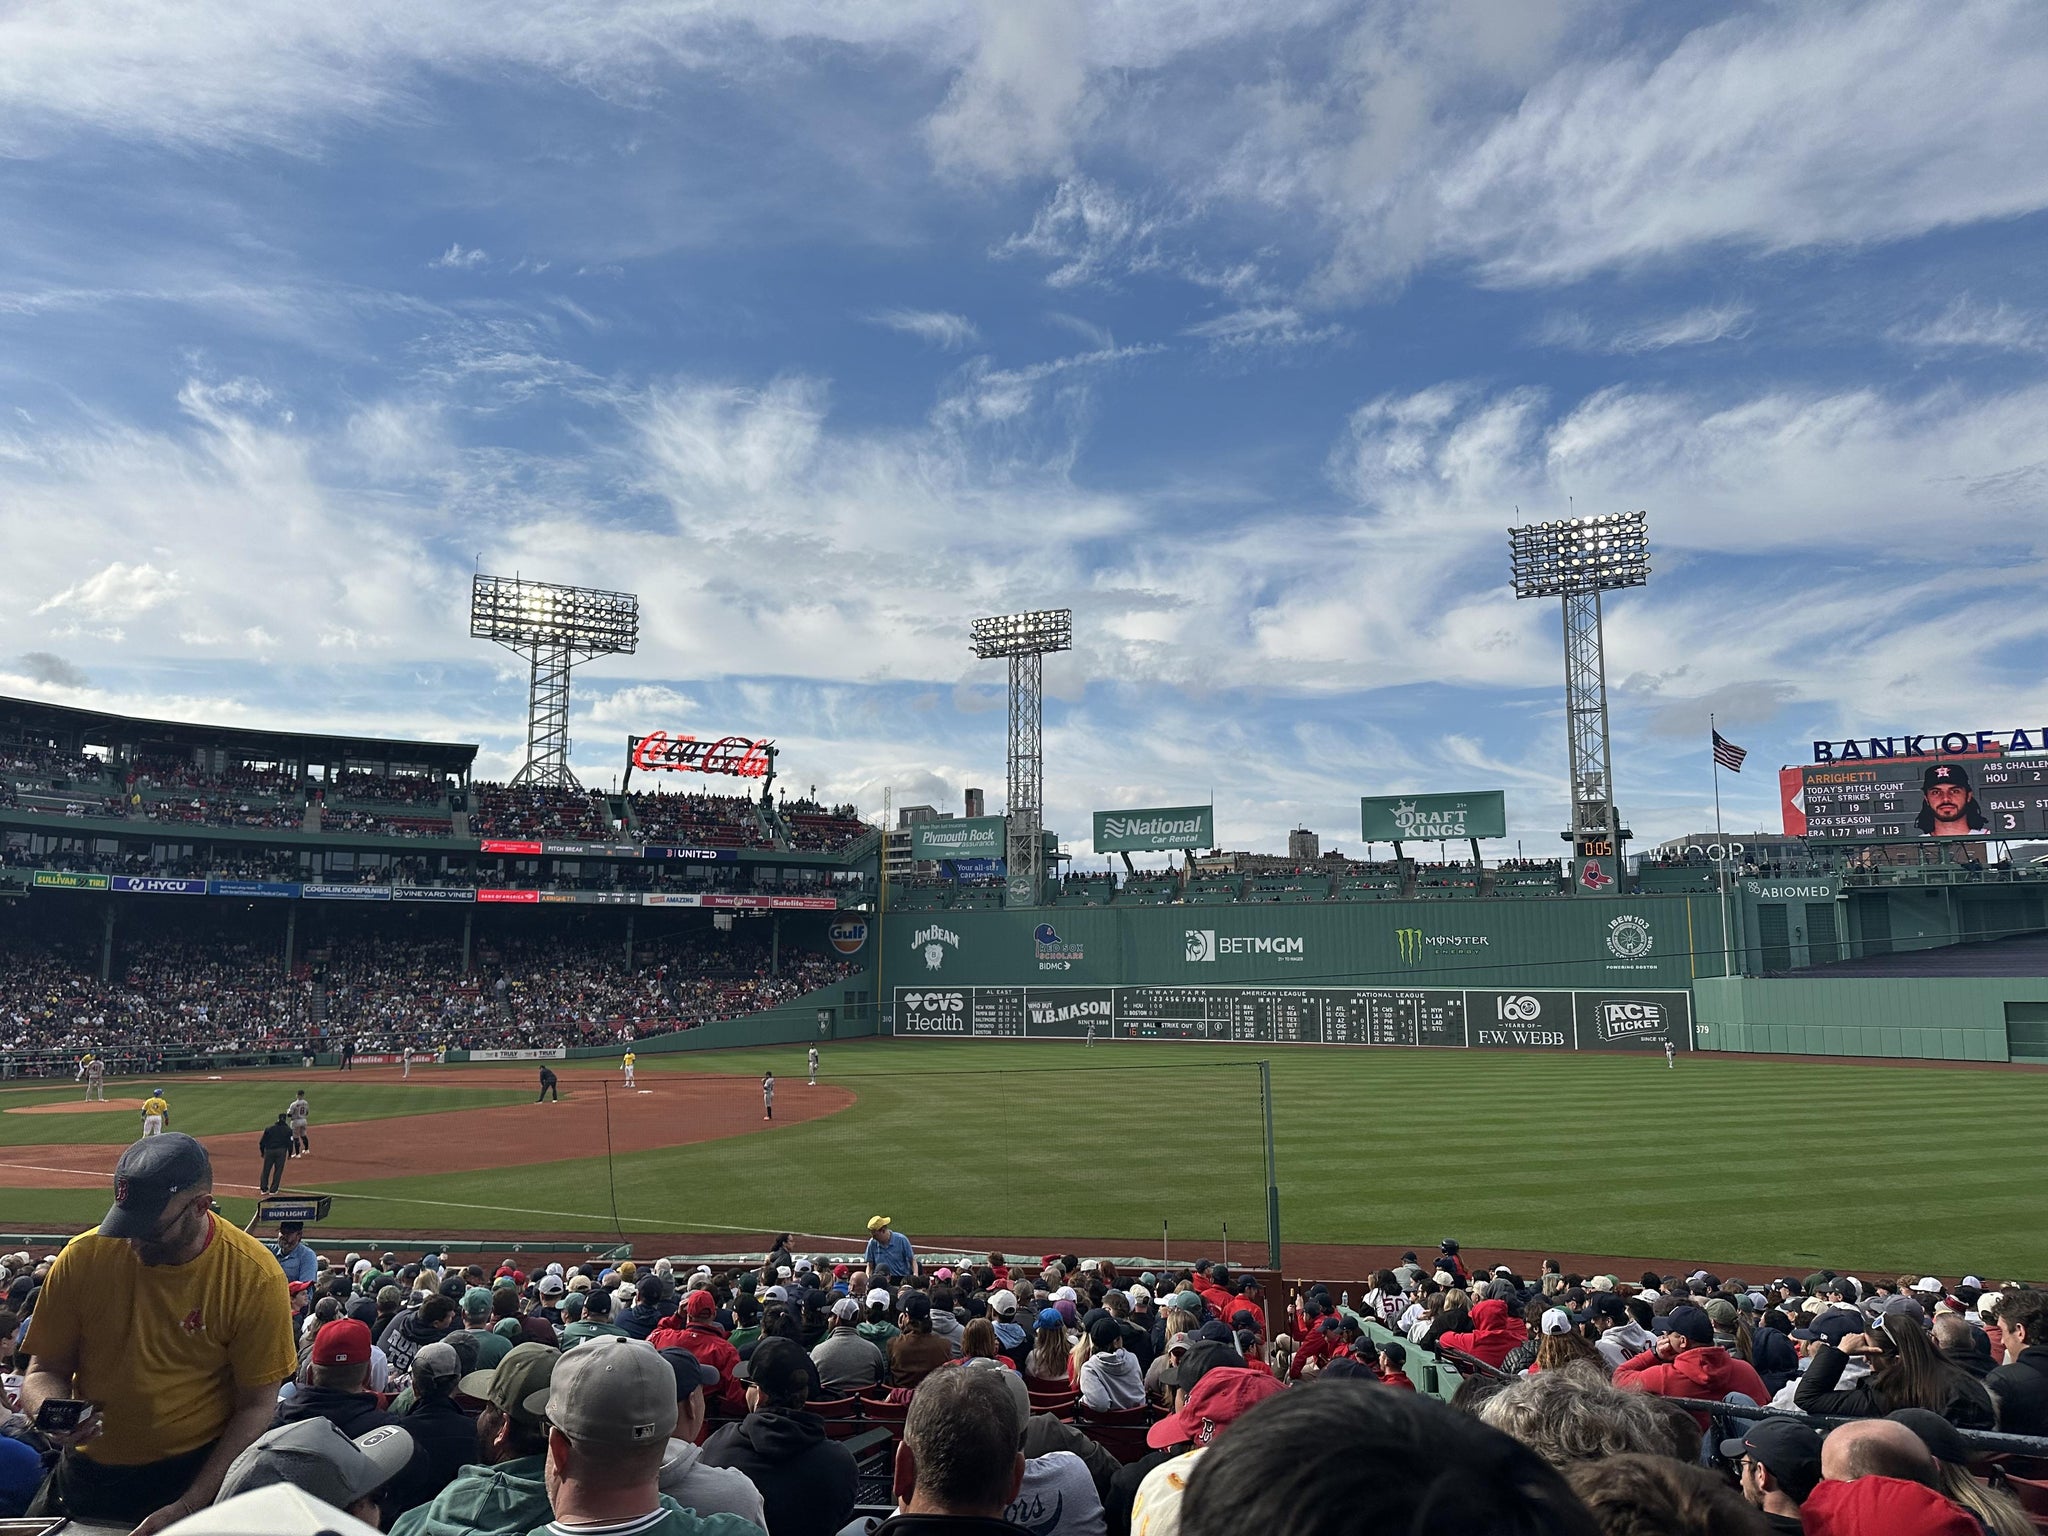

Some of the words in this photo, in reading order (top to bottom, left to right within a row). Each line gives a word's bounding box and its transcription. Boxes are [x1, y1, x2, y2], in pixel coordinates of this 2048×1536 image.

[1814, 735, 1927, 763] BANK
[1942, 731, 1994, 755] OF
[1984, 763, 2003, 771] ABS
[1807, 771, 1877, 784] ARRIGHETTI
[1986, 774, 2008, 783] HOU
[2033, 771, 2041, 781] 2
[1807, 785, 1843, 795] TODAY'S
[1846, 784, 1872, 793] PITCH
[1874, 782, 1904, 792] COUNT
[1838, 793, 1870, 801] STRIKES
[1880, 792, 1896, 800] PCT
[1814, 805, 1827, 814] 37
[1850, 803, 1860, 812] 19
[1884, 801, 1894, 810] 51
[1990, 800, 2025, 810] BALLS
[1395, 810, 1468, 828] DRAFT
[1810, 817, 1832, 826] 2026
[1835, 815, 1871, 824] SEASON
[2003, 813, 2016, 829] 3
[1126, 815, 1202, 837] National
[1405, 823, 1466, 838] KINGS
[1808, 830, 1825, 838] ERA
[1831, 828, 1850, 837] 1.77
[1857, 827, 1876, 836] WHIP
[1882, 826, 1900, 835] 1.13
[923, 829, 968, 844] Plymouth
[970, 828, 995, 842] Rock
[1151, 836, 1167, 844] Car
[1169, 834, 1198, 844] Rental
[975, 863, 1000, 871] all-str
[36, 876, 77, 886] SULLIVAN
[89, 879, 107, 887] TIRE
[147, 880, 187, 890] HYCU
[304, 886, 340, 895] COGHLIN
[341, 887, 389, 897] COMPANIES
[404, 890, 448, 898] VINEYARD
[450, 891, 473, 899] VINES
[1760, 886, 1830, 898] ABIOMED
[773, 899, 804, 908] Safelite
[1607, 915, 1633, 930] IBEW
[1633, 916, 1650, 930] 103
[911, 930, 931, 950] JIM
[931, 924, 960, 950] BEAM
[1039, 944, 1061, 952] RED
[1062, 944, 1084, 952] SOX
[1220, 937, 1303, 954] BETMGM
[1039, 952, 1084, 960] SCHOLARS
[1039, 962, 1063, 970] BIDMC
[924, 992, 964, 1012] CVS
[1497, 995, 1541, 1020] 160
[1609, 1003, 1660, 1022] ACE
[906, 1013, 964, 1031] Health
[1611, 1019, 1660, 1033] TICKET
[1695, 1025, 1709, 1034] 379
[1478, 1030, 1509, 1044] F.W.
[1513, 1031, 1565, 1046] WEBB
[269, 1210, 285, 1218] BUD
[286, 1209, 308, 1218] LIGHT
